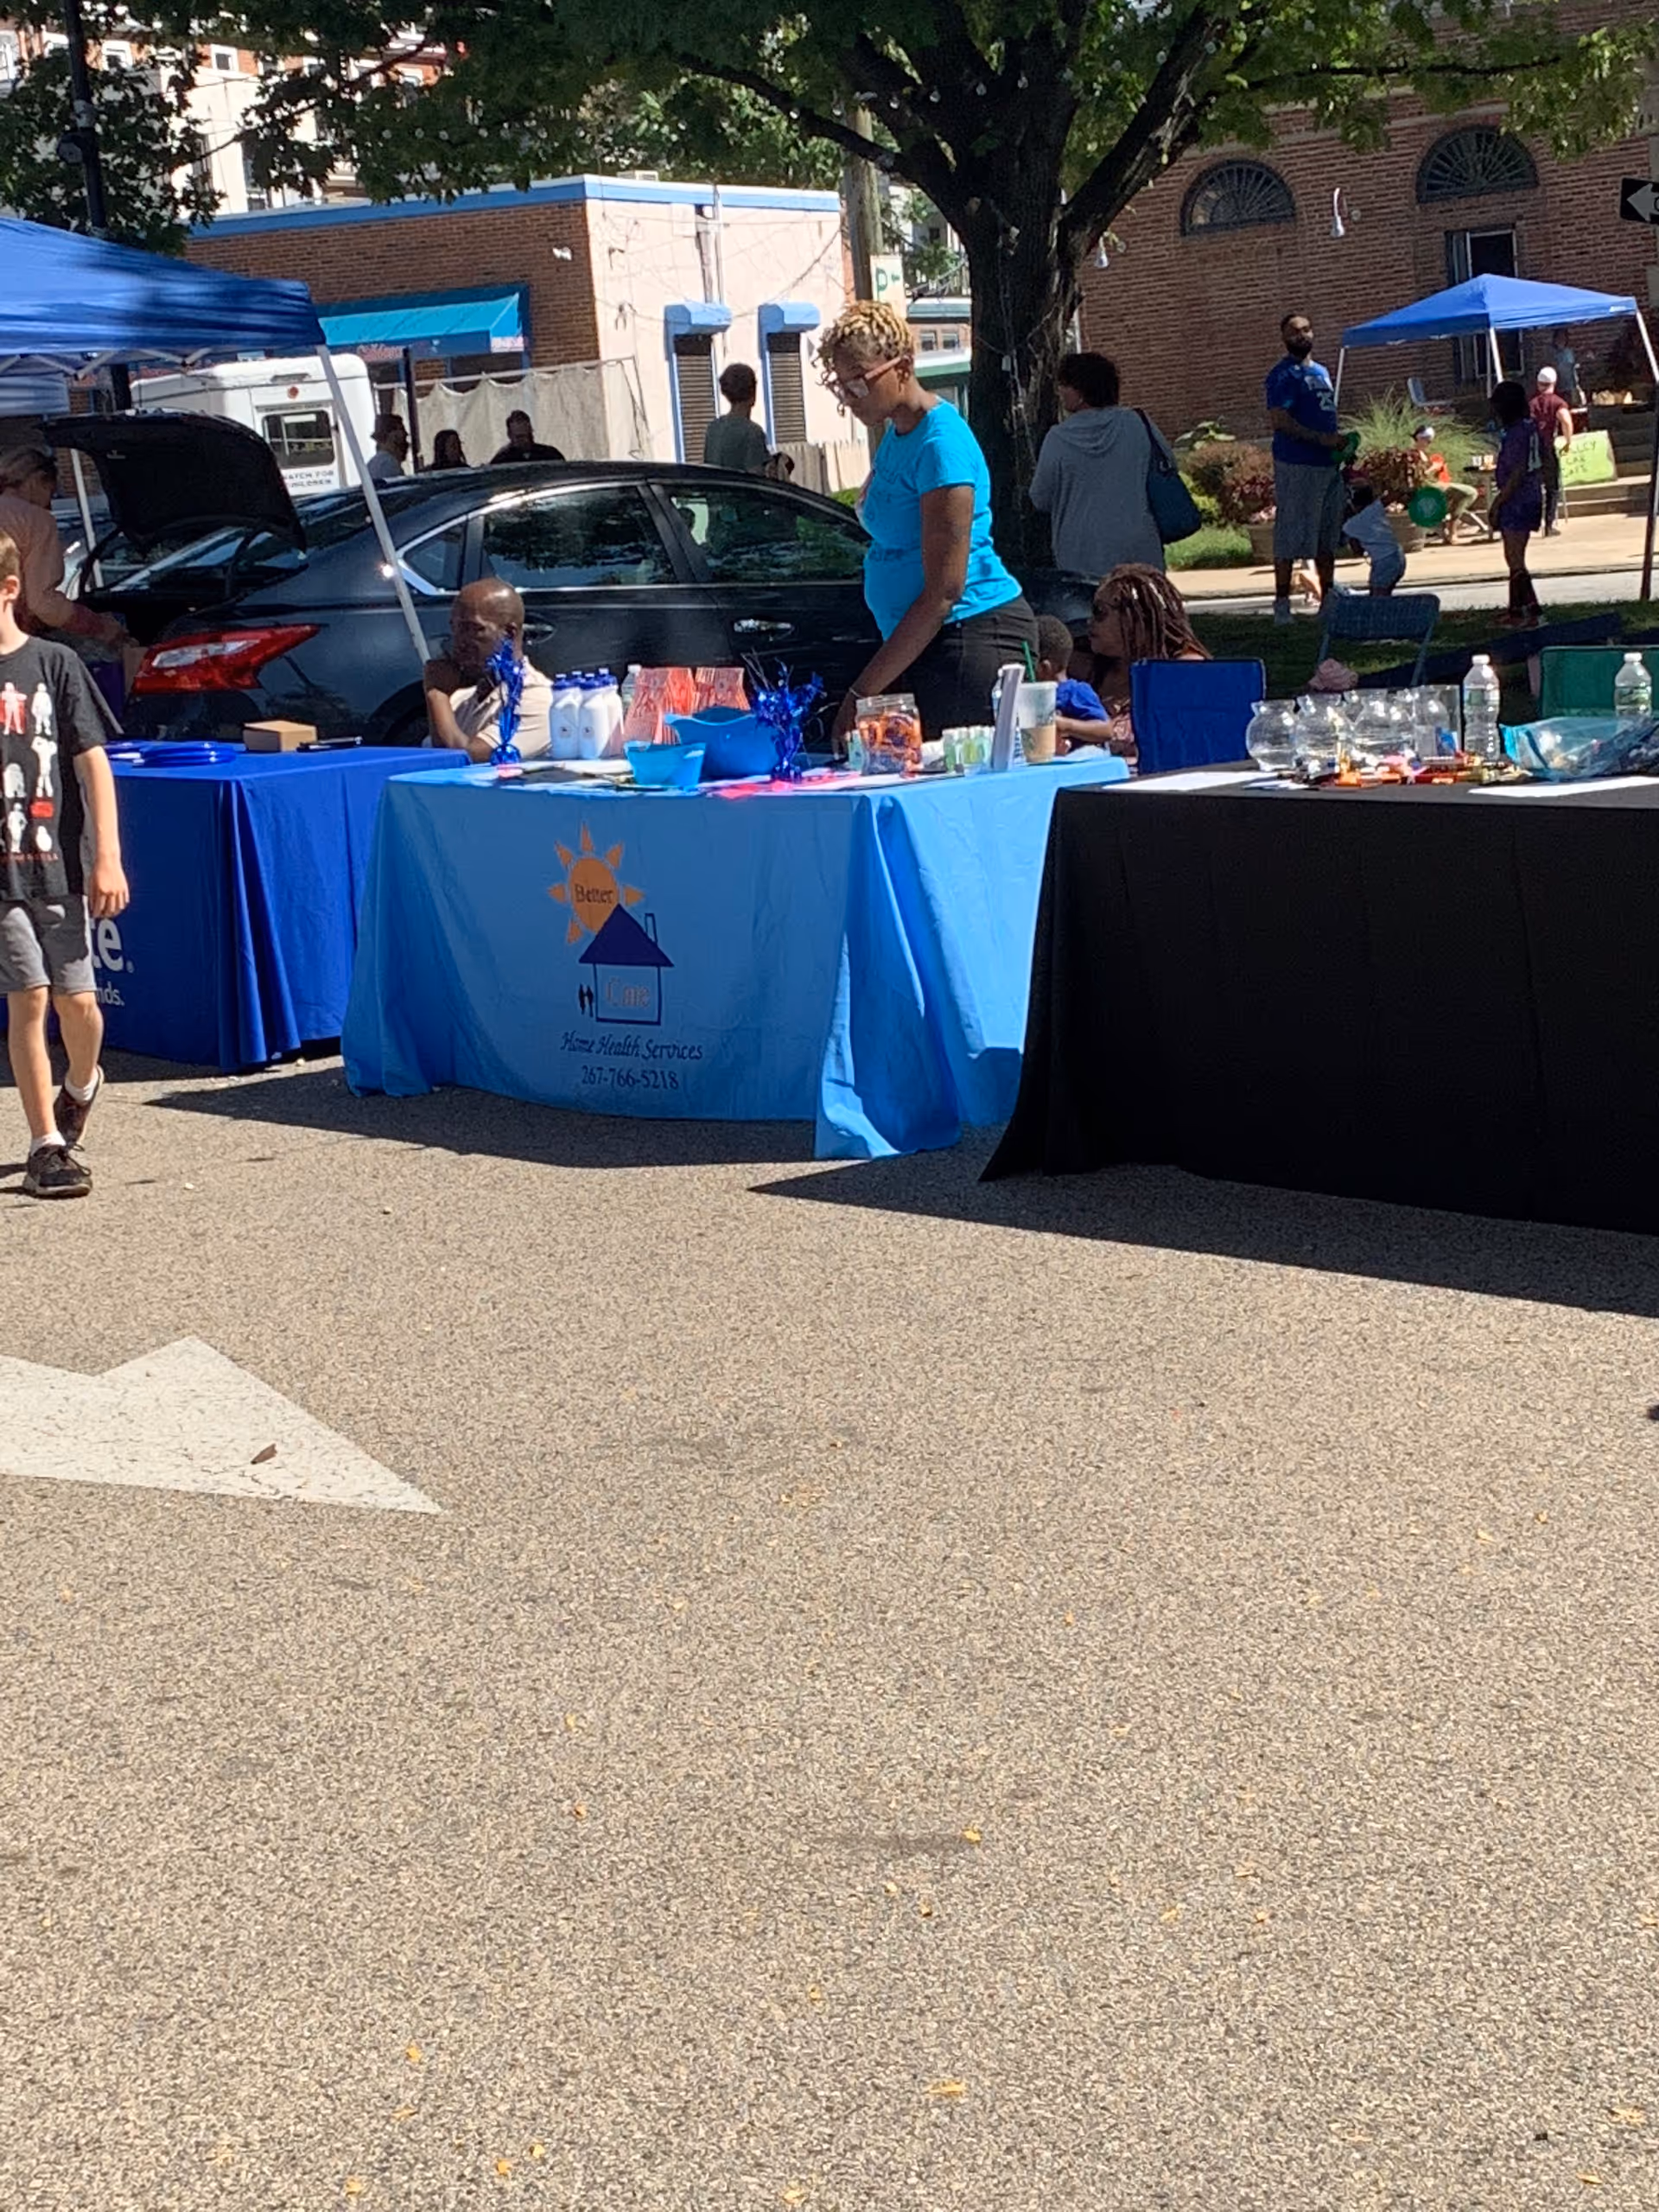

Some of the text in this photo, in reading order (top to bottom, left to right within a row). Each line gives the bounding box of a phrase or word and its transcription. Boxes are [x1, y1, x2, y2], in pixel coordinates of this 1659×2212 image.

[575, 883, 613, 904] Better
[560, 1030, 703, 1060] Home Health Services
[581, 1065, 679, 1090] 267-766-5218
